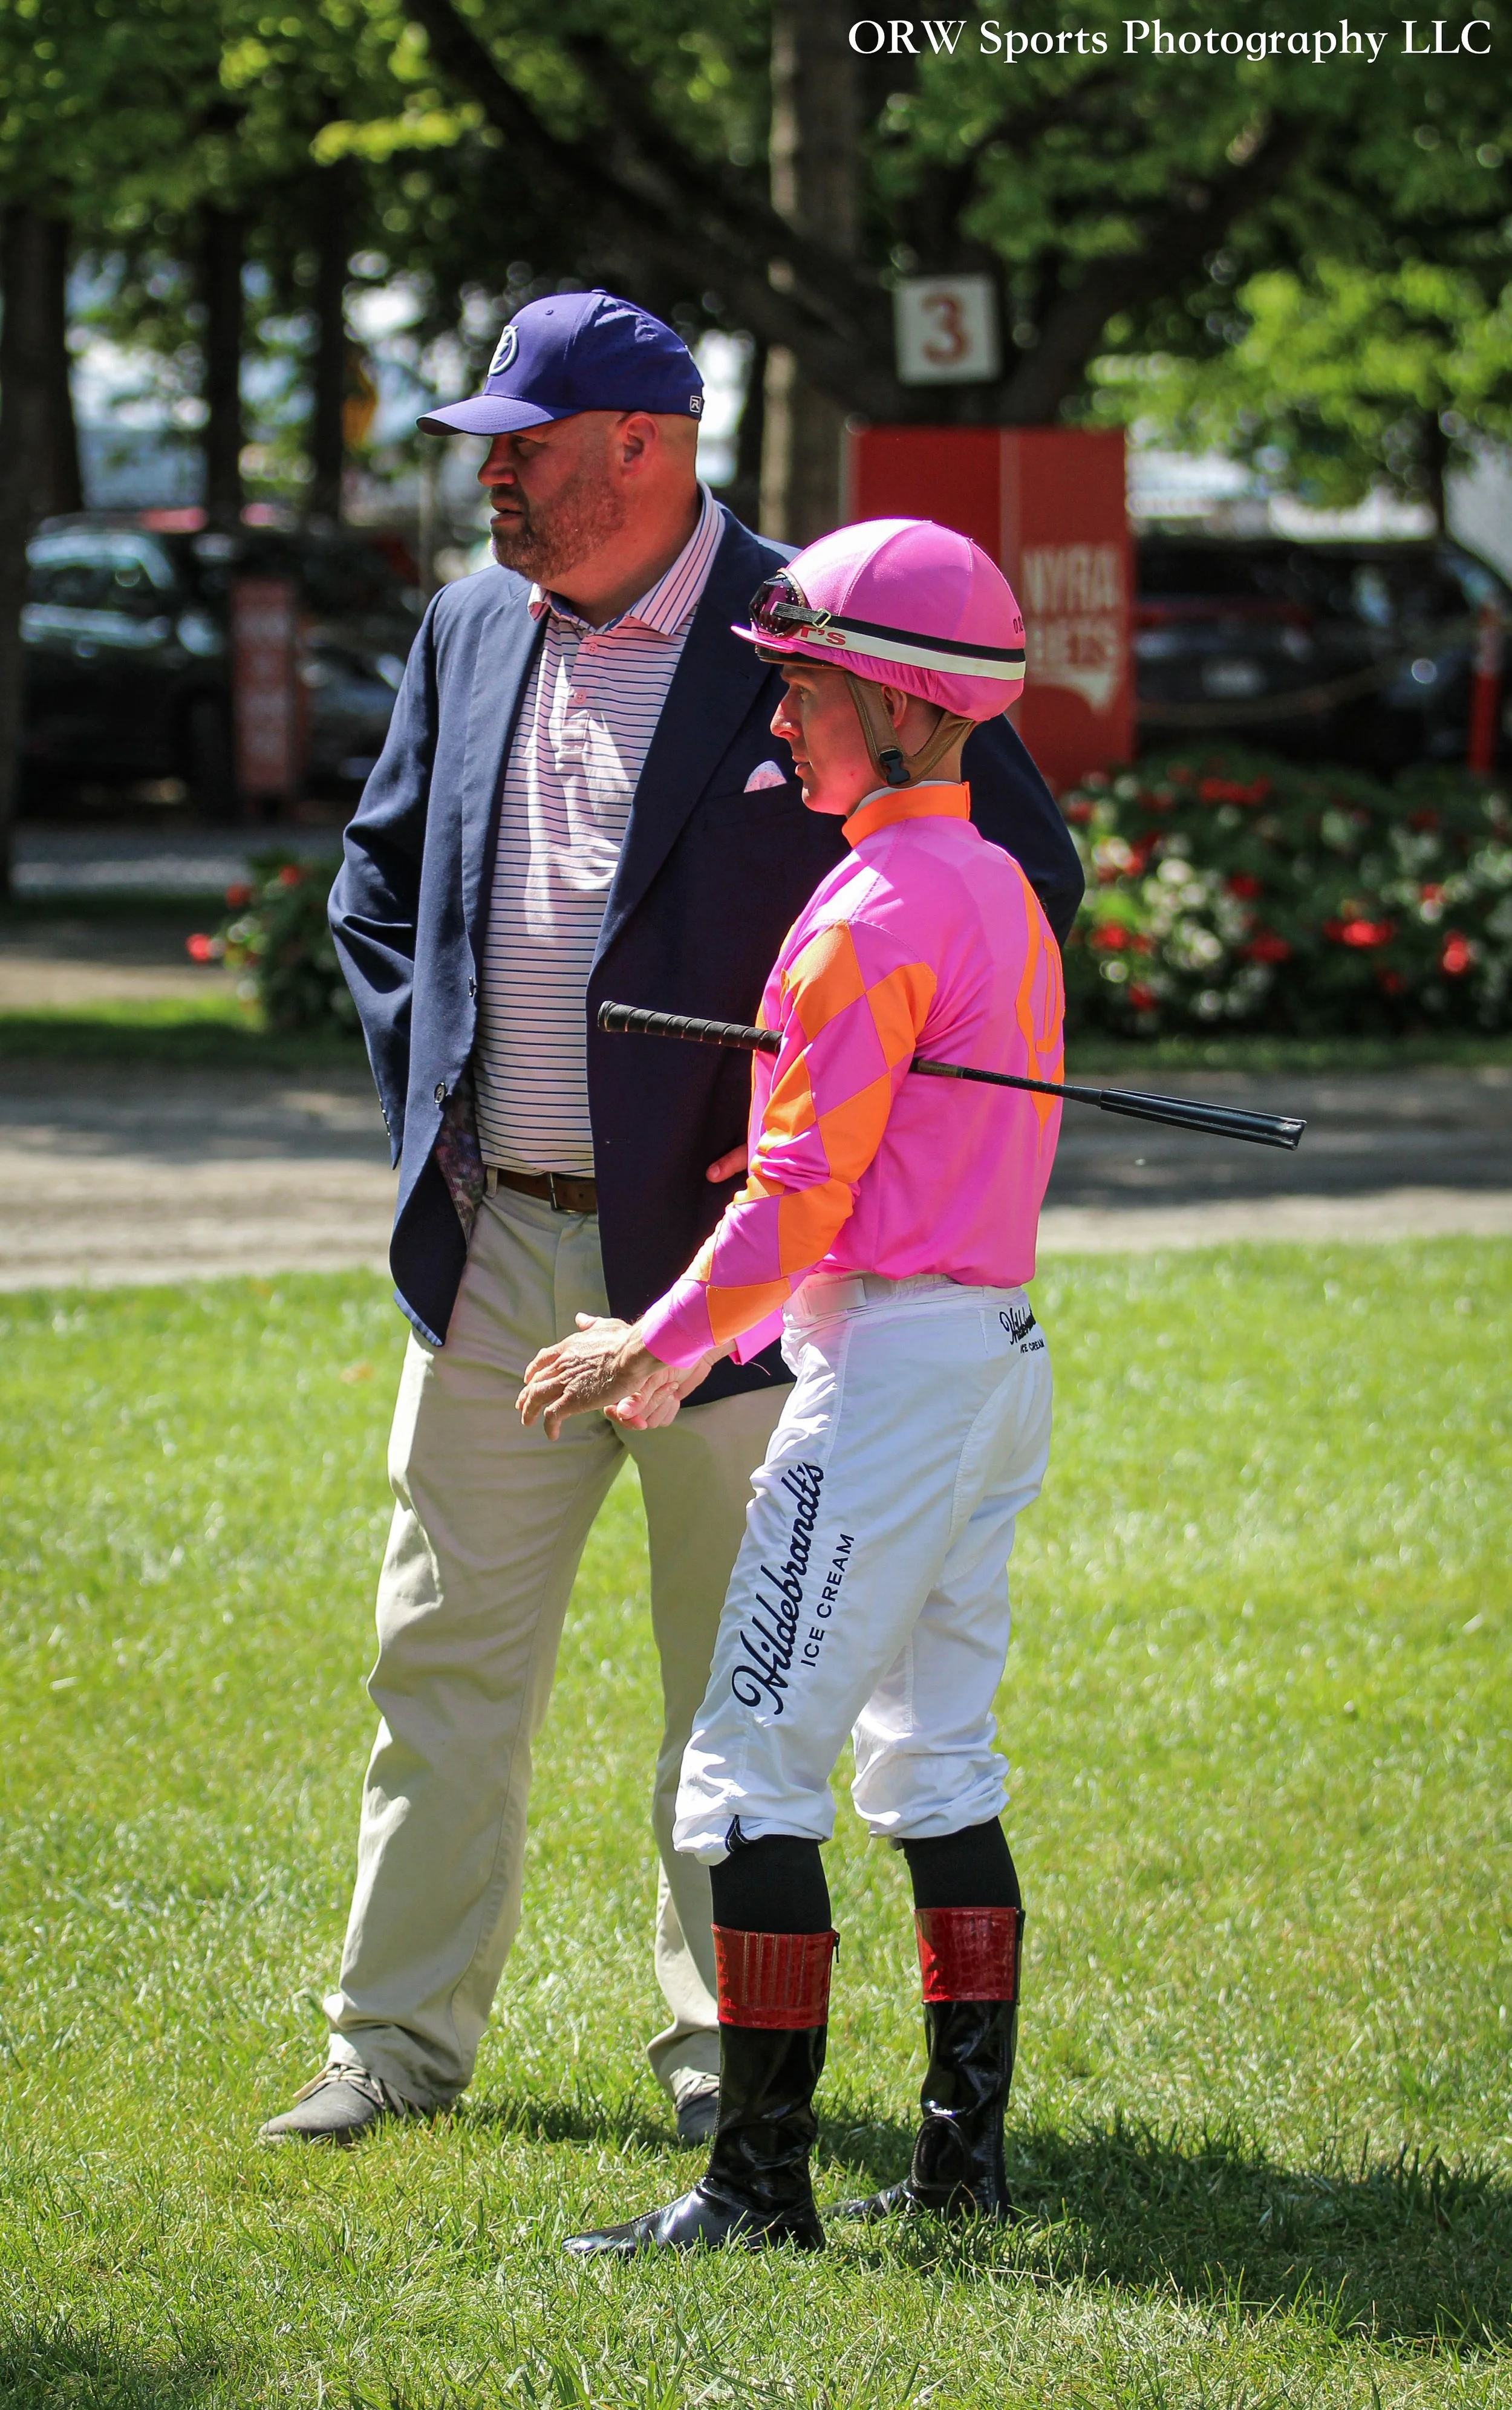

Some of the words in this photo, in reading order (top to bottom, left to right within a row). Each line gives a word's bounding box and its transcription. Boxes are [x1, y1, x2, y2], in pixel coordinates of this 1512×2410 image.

[921, 293, 967, 365] 3
[1022, 548, 1116, 611] NYRA
[731, 1462, 825, 1715] Hildebrandt's
[800, 1626, 826, 1668] ICE
[816, 1533, 855, 1619] CREAM
